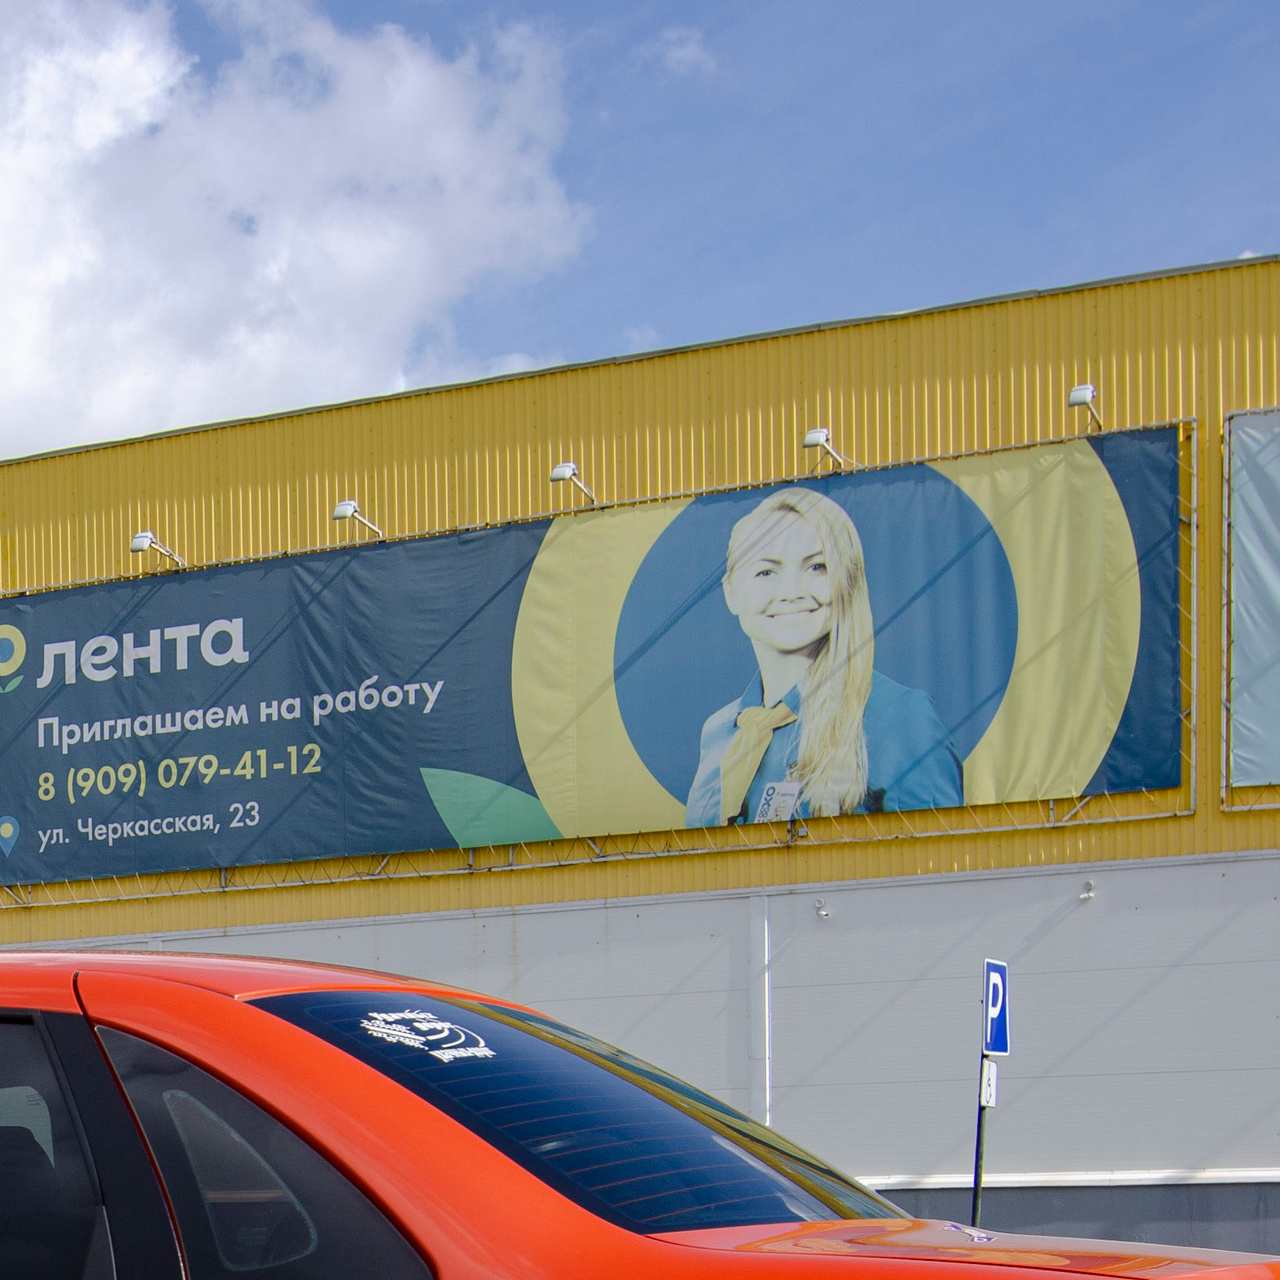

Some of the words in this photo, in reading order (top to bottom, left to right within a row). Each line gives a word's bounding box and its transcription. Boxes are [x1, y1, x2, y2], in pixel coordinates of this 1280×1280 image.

[36, 616, 249, 689] лента
[37, 702, 249, 755] Приглашаем
[260, 697, 301, 724] на
[313, 675, 445, 726] работу
[38, 772, 56, 801] 8
[67, 759, 147, 805] (909)
[158, 743, 322, 789] 079-41-12
[37, 827, 70, 853] ул.
[77, 811, 220, 847] Черкасская,
[229, 801, 260, 829] 23
[987, 972, 1003, 1042] P
